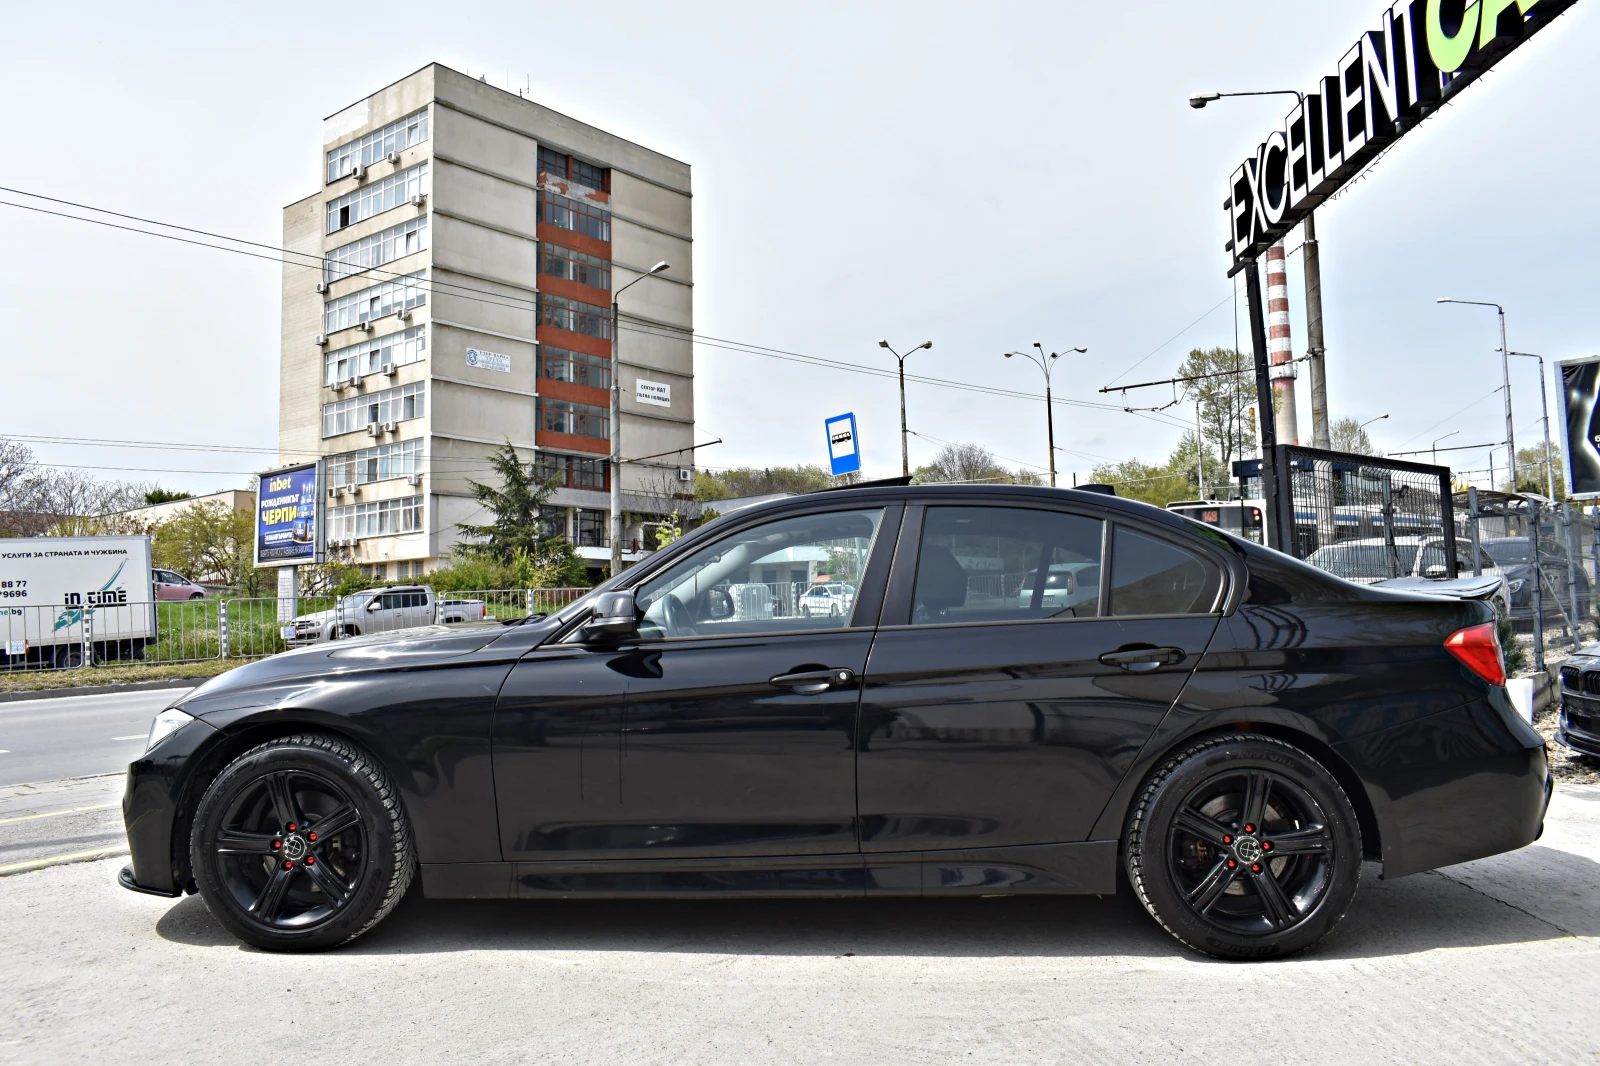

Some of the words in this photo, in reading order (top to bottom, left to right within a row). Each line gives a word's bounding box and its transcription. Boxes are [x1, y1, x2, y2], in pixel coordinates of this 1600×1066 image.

[1230, 0, 1418, 257] EXCELLENT
[269, 476, 292, 493] inbet
[261, 493, 300, 509] РОЖДЕНИКЪТ
[262, 505, 298, 525] ЧЕРПИ
[44, 550, 83, 558] СТРАНАТА
[16, 580, 27, 588] 77
